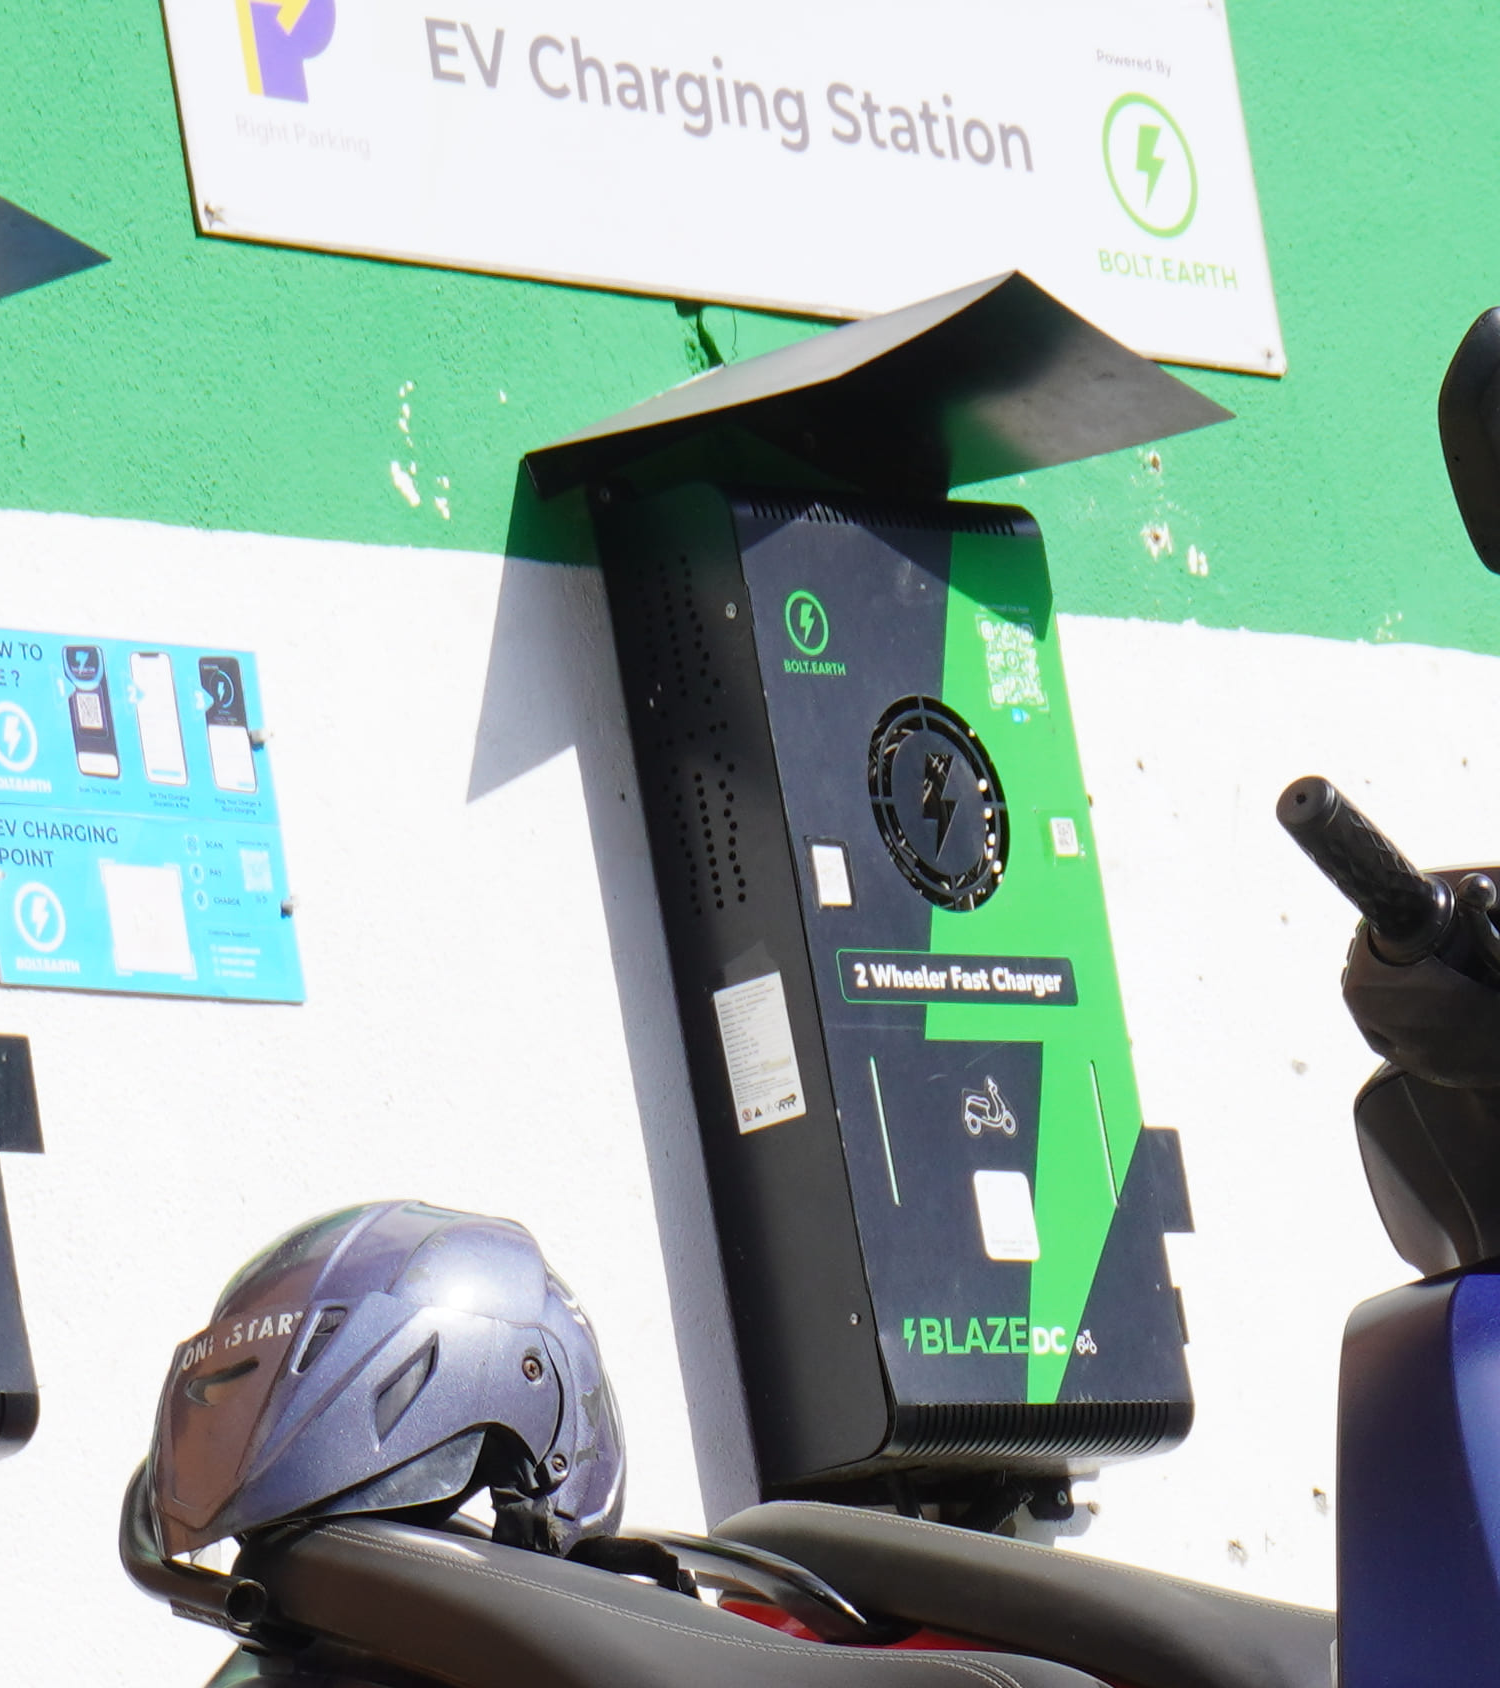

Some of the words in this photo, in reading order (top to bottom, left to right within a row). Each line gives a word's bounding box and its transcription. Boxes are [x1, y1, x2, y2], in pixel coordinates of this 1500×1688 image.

[1096, 49, 1152, 72] Powered
[1156, 59, 1172, 78] By
[425, 17, 506, 91] EV
[530, 36, 810, 153] Charging
[827, 82, 1034, 175] Station
[1098, 248, 1239, 290] BOLT.EARTH
[18, 642, 43, 661] TO
[10, 670, 20, 687] ?
[784, 659, 847, 677] BOLT.EARTH
[23, 820, 118, 844] CHARGING
[854, 963, 869, 988] 2
[871, 963, 947, 991] Wheeler
[950, 965, 988, 992] Fast
[992, 967, 1062, 997] Charger
